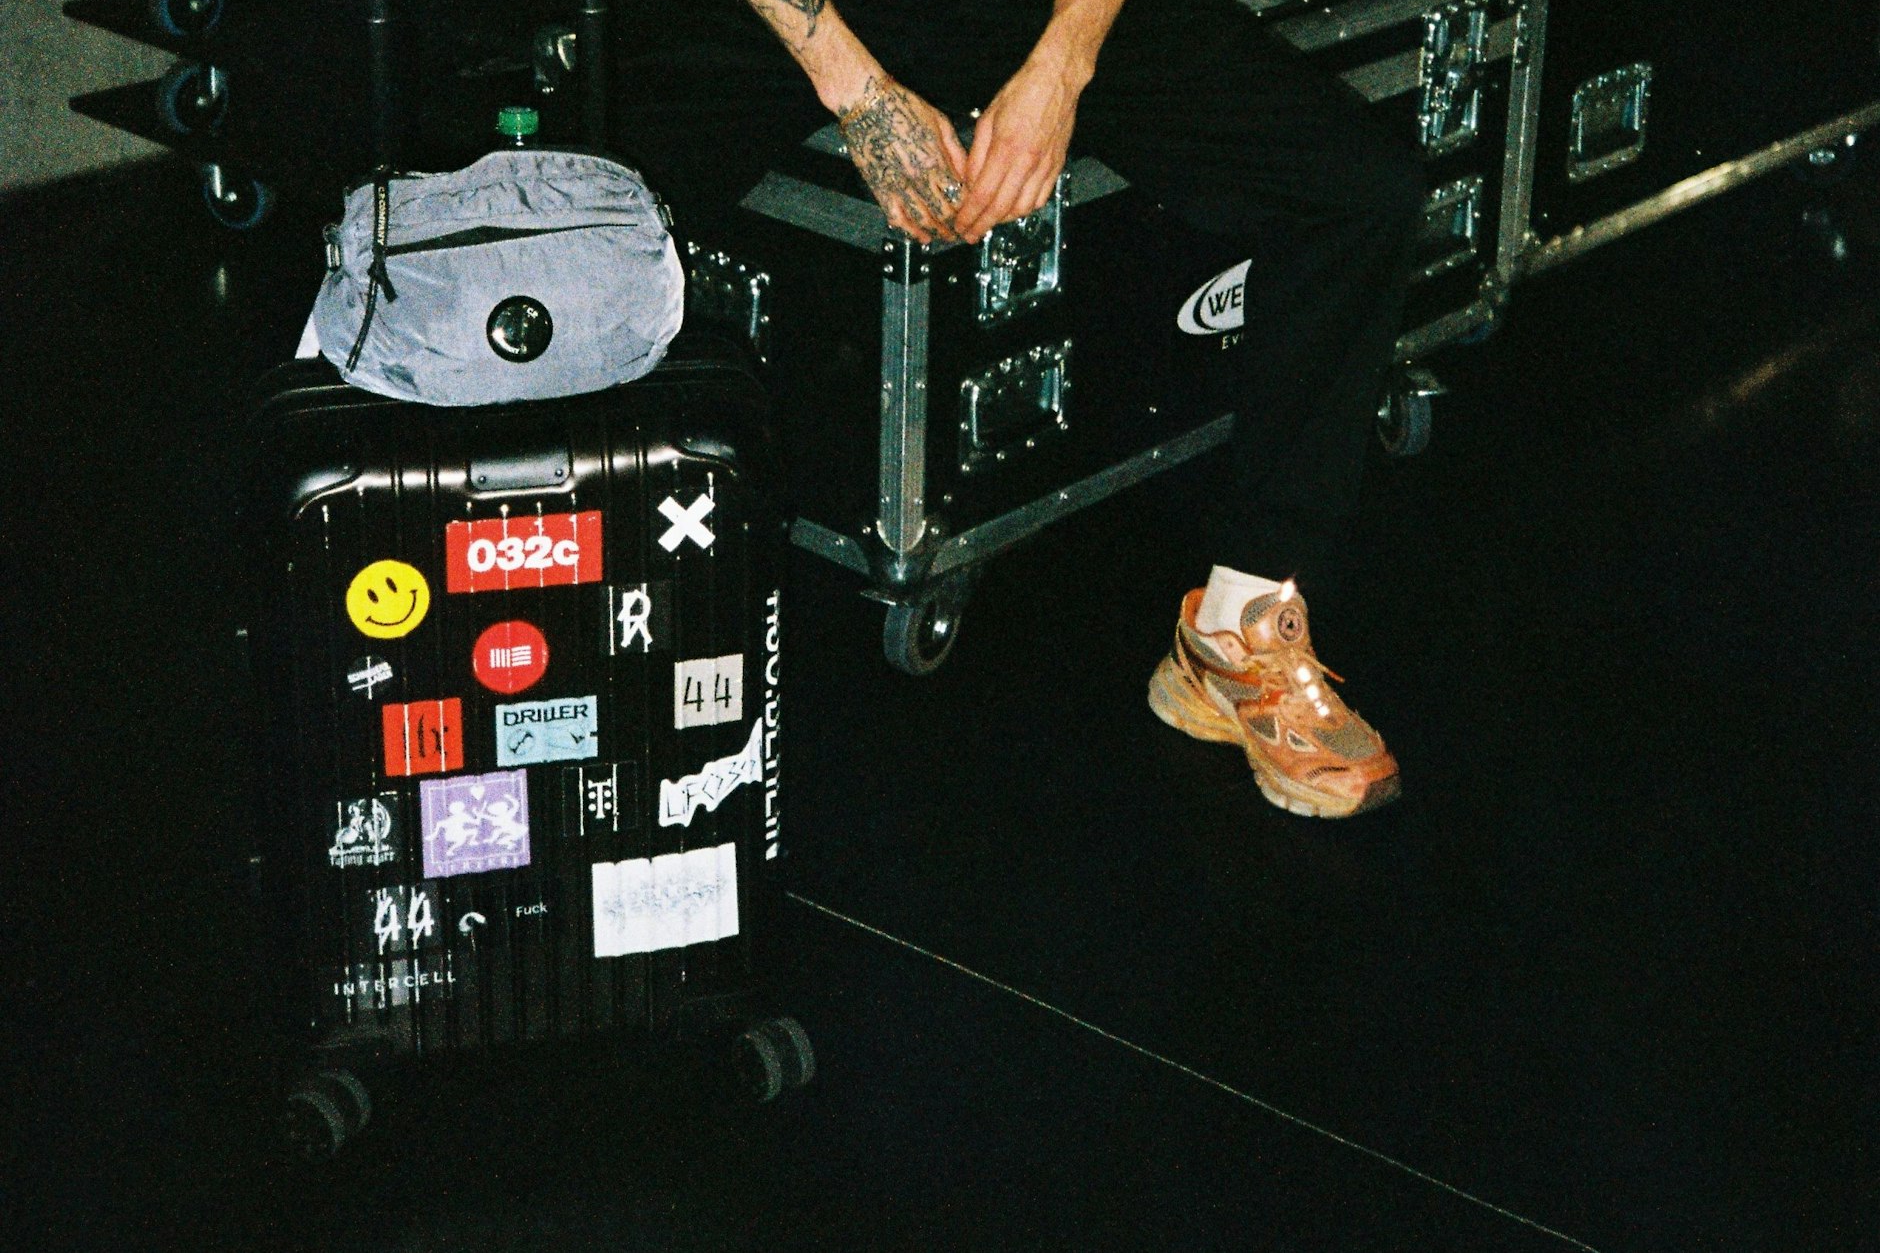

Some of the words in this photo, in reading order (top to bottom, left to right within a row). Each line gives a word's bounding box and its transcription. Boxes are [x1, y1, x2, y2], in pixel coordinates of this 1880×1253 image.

[467, 535, 580, 572] 032c
[503, 704, 588, 726] DRILLER
[333, 970, 457, 996] INTERCELL
